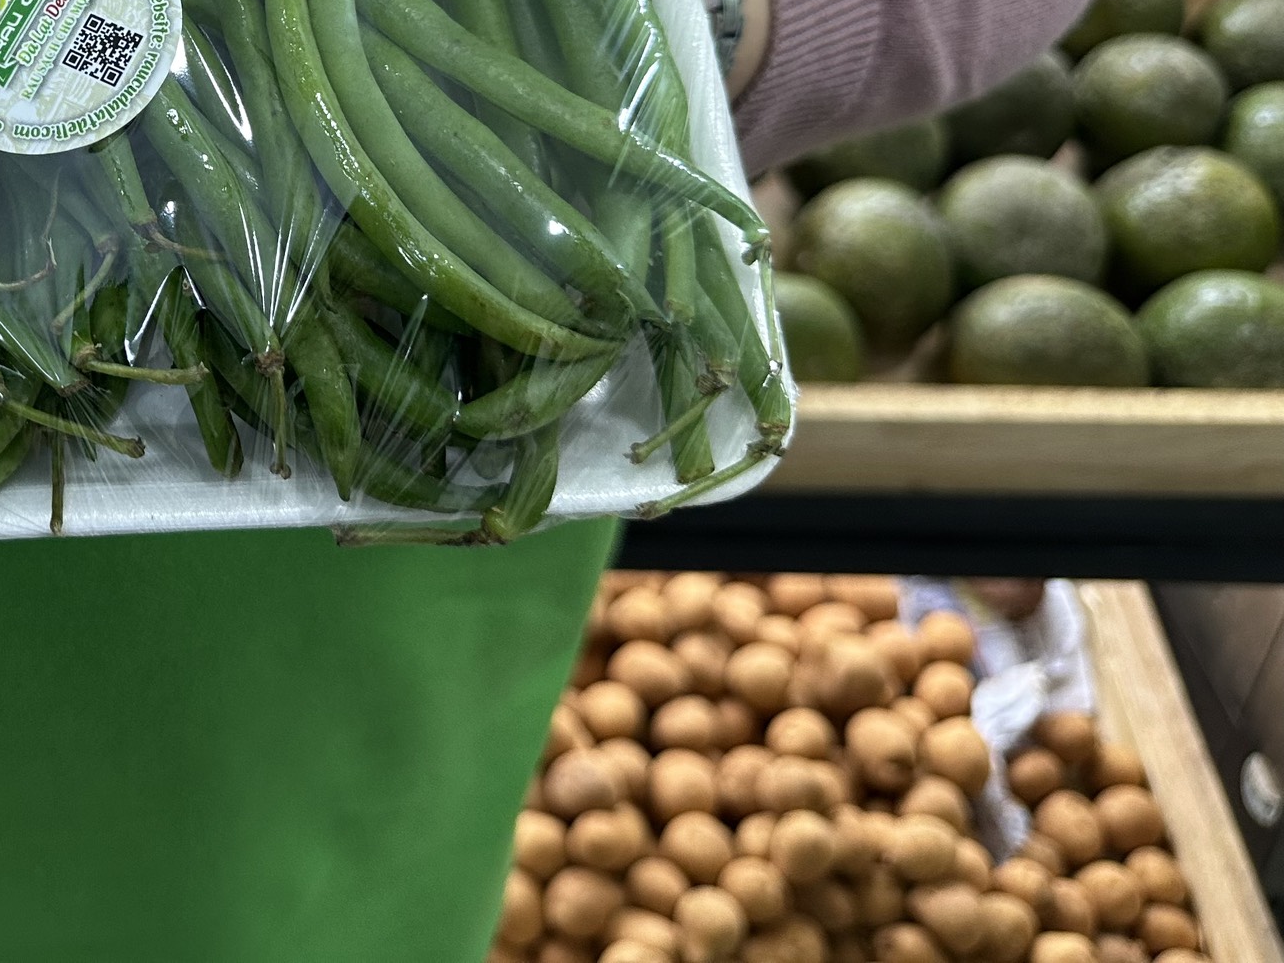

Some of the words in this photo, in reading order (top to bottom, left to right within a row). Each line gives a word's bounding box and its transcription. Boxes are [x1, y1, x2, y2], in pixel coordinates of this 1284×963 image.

[18, 42, 39, 65] Đà
[30, 18, 54, 43] Lạt
[20, 72, 42, 99] RAU
[37, 41, 61, 73] SẠCH
[56, 16, 76, 42] CHO
[15, 53, 159, 138] raucudalatdeli.com
